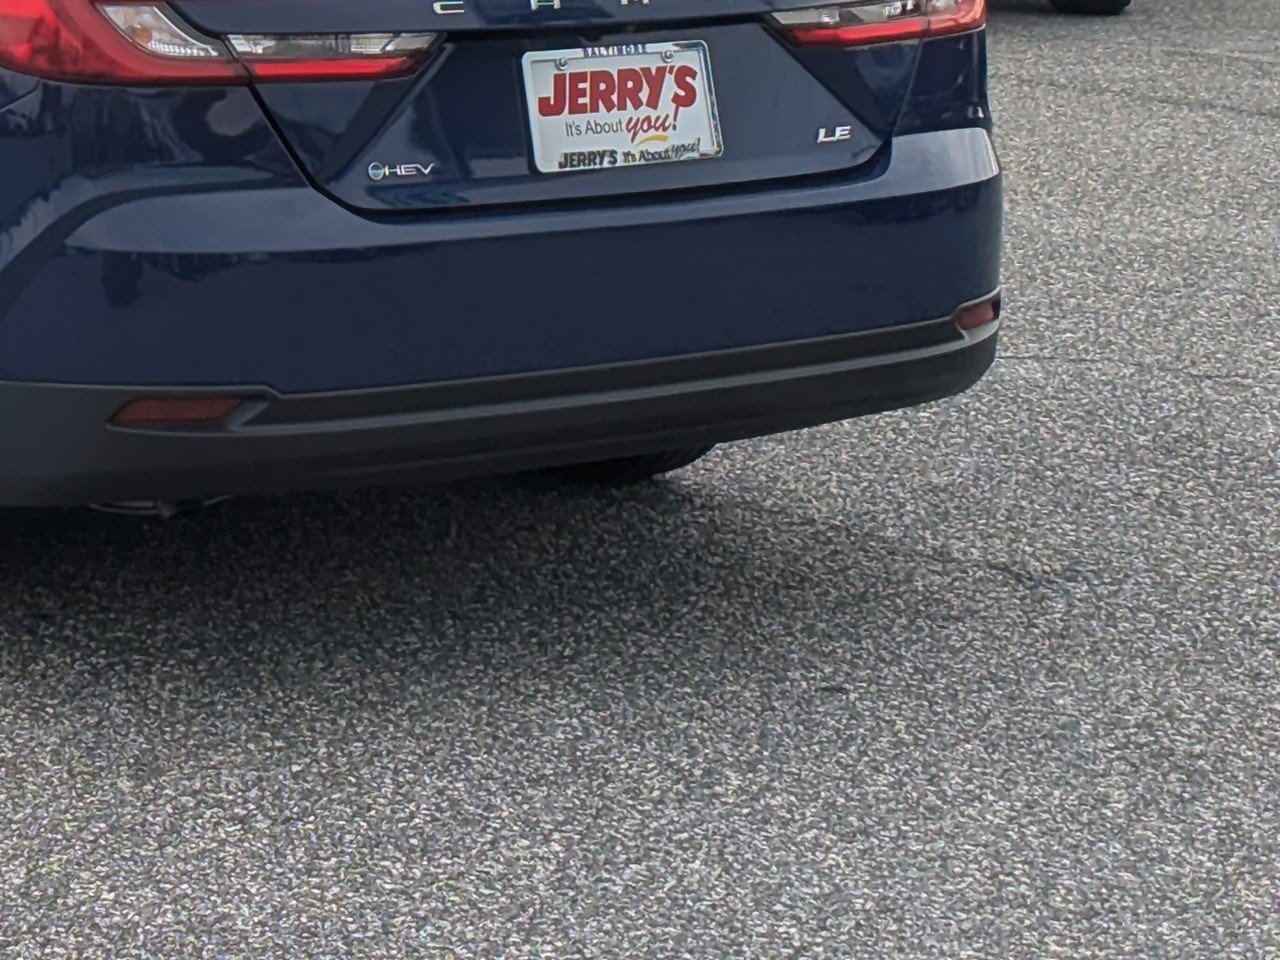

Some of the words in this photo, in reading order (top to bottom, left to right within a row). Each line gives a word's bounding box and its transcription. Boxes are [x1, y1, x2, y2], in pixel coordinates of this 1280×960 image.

[538, 64, 699, 117] JERRY'S
[565, 120, 582, 138] It's
[585, 119, 624, 136] About
[624, 106, 680, 144] you!
[816, 125, 852, 144] LE
[558, 148, 619, 170] JERRY'S
[638, 147, 671, 164] About
[670, 137, 702, 158] you!
